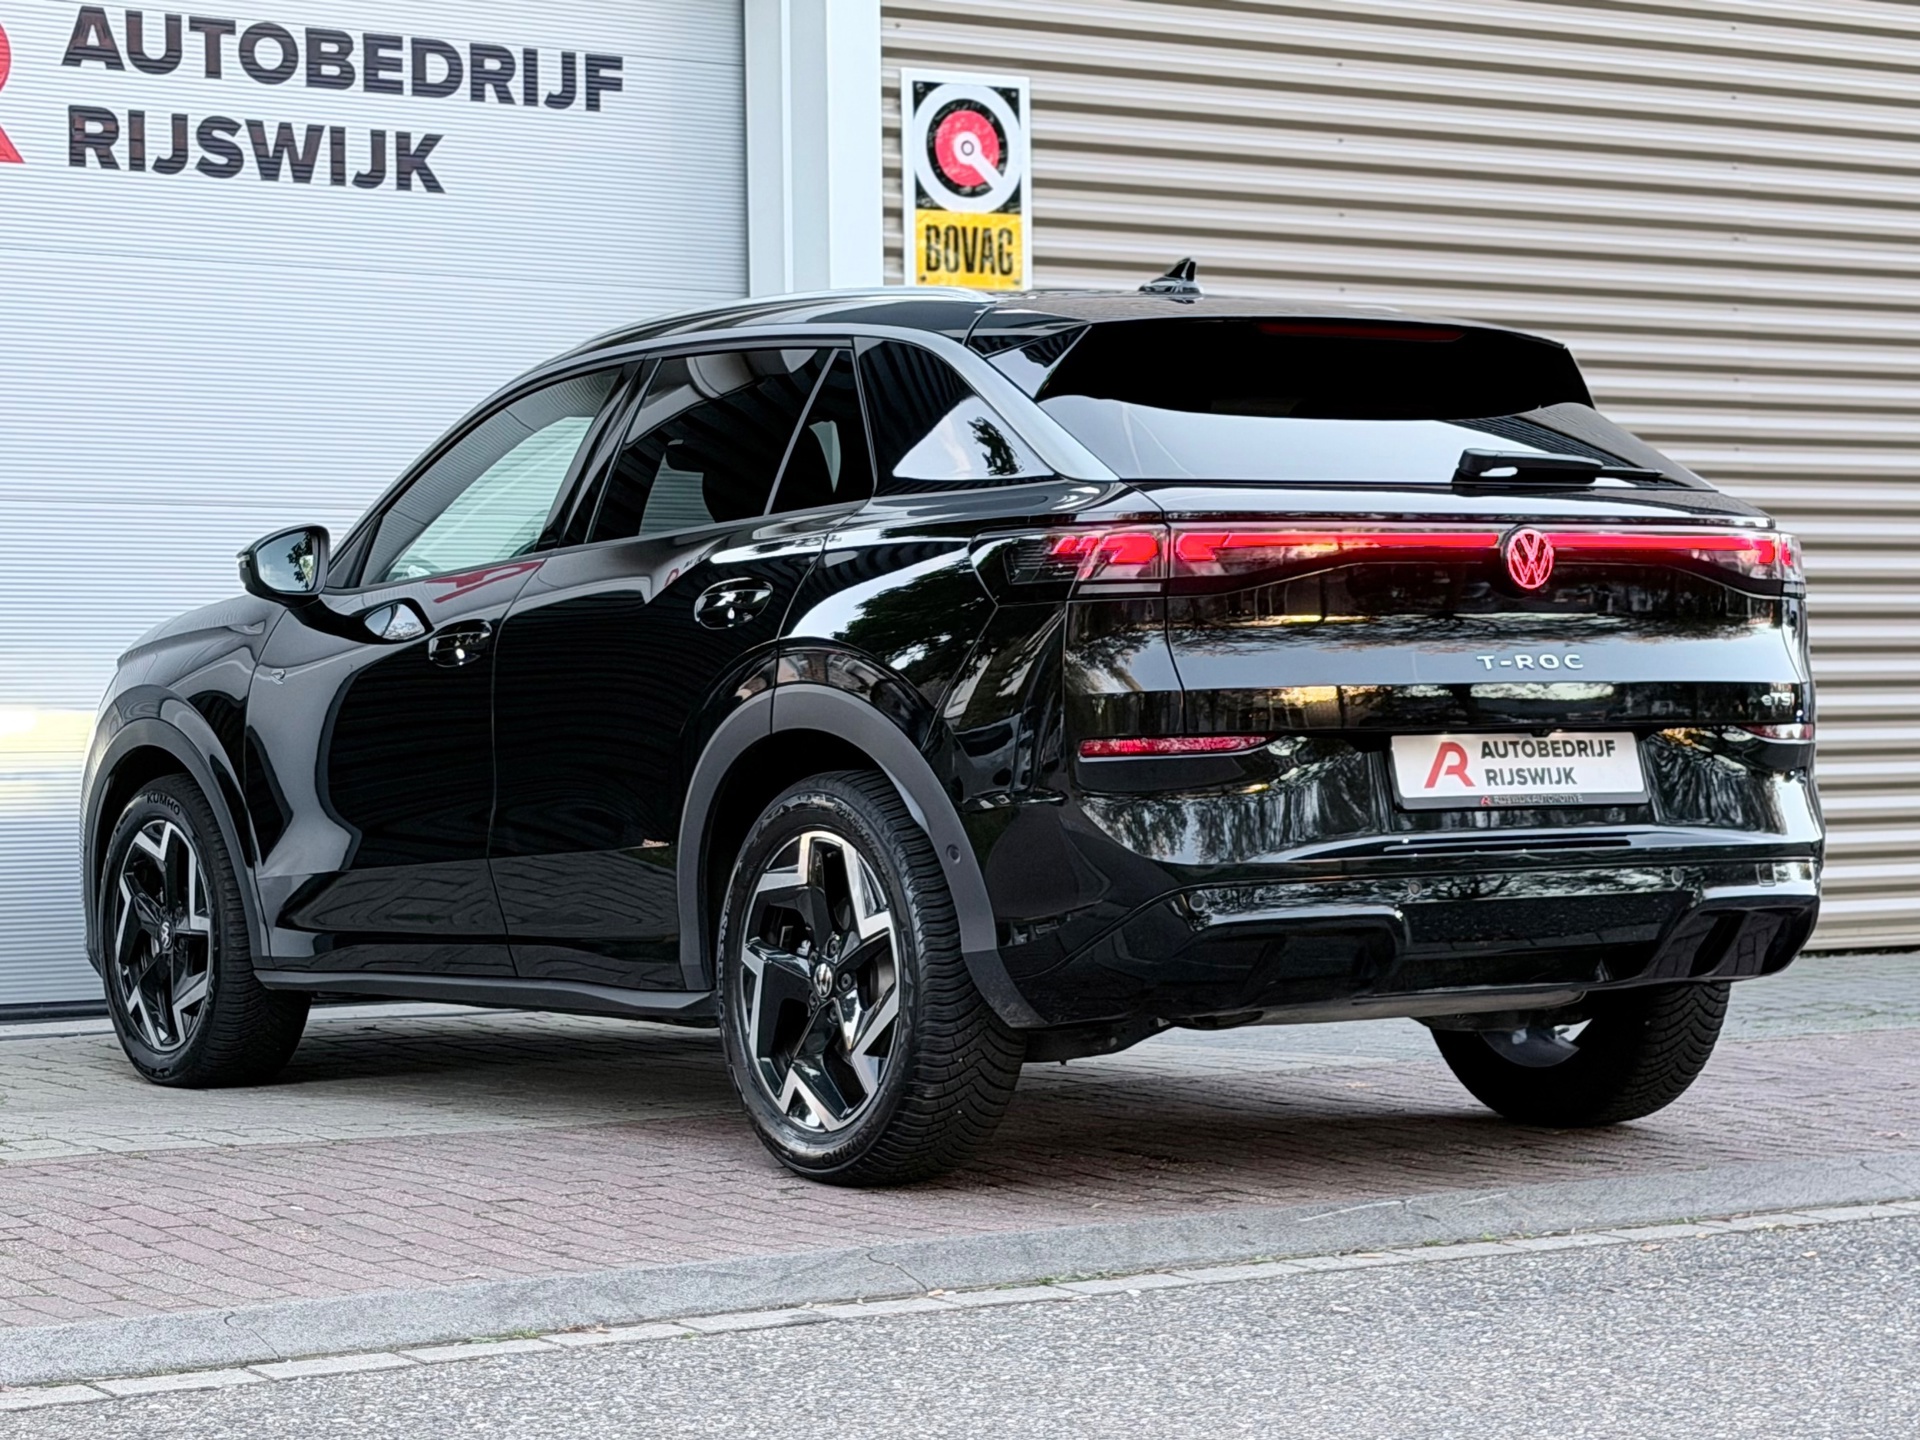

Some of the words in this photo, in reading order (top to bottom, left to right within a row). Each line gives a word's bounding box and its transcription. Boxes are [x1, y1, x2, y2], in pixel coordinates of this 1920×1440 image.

[61, 5, 624, 112] AUTOBEDRIJF
[67, 104, 446, 194] RIJSWIJK
[925, 224, 1014, 276] BOVAG
[1477, 653, 1584, 670] T-ROC
[1761, 692, 1795, 707] eTSI
[1480, 739, 1616, 759] AUTOBEDRIJF
[1484, 766, 1578, 787] RIJSWIJK
[146, 791, 181, 816] KUMHO
